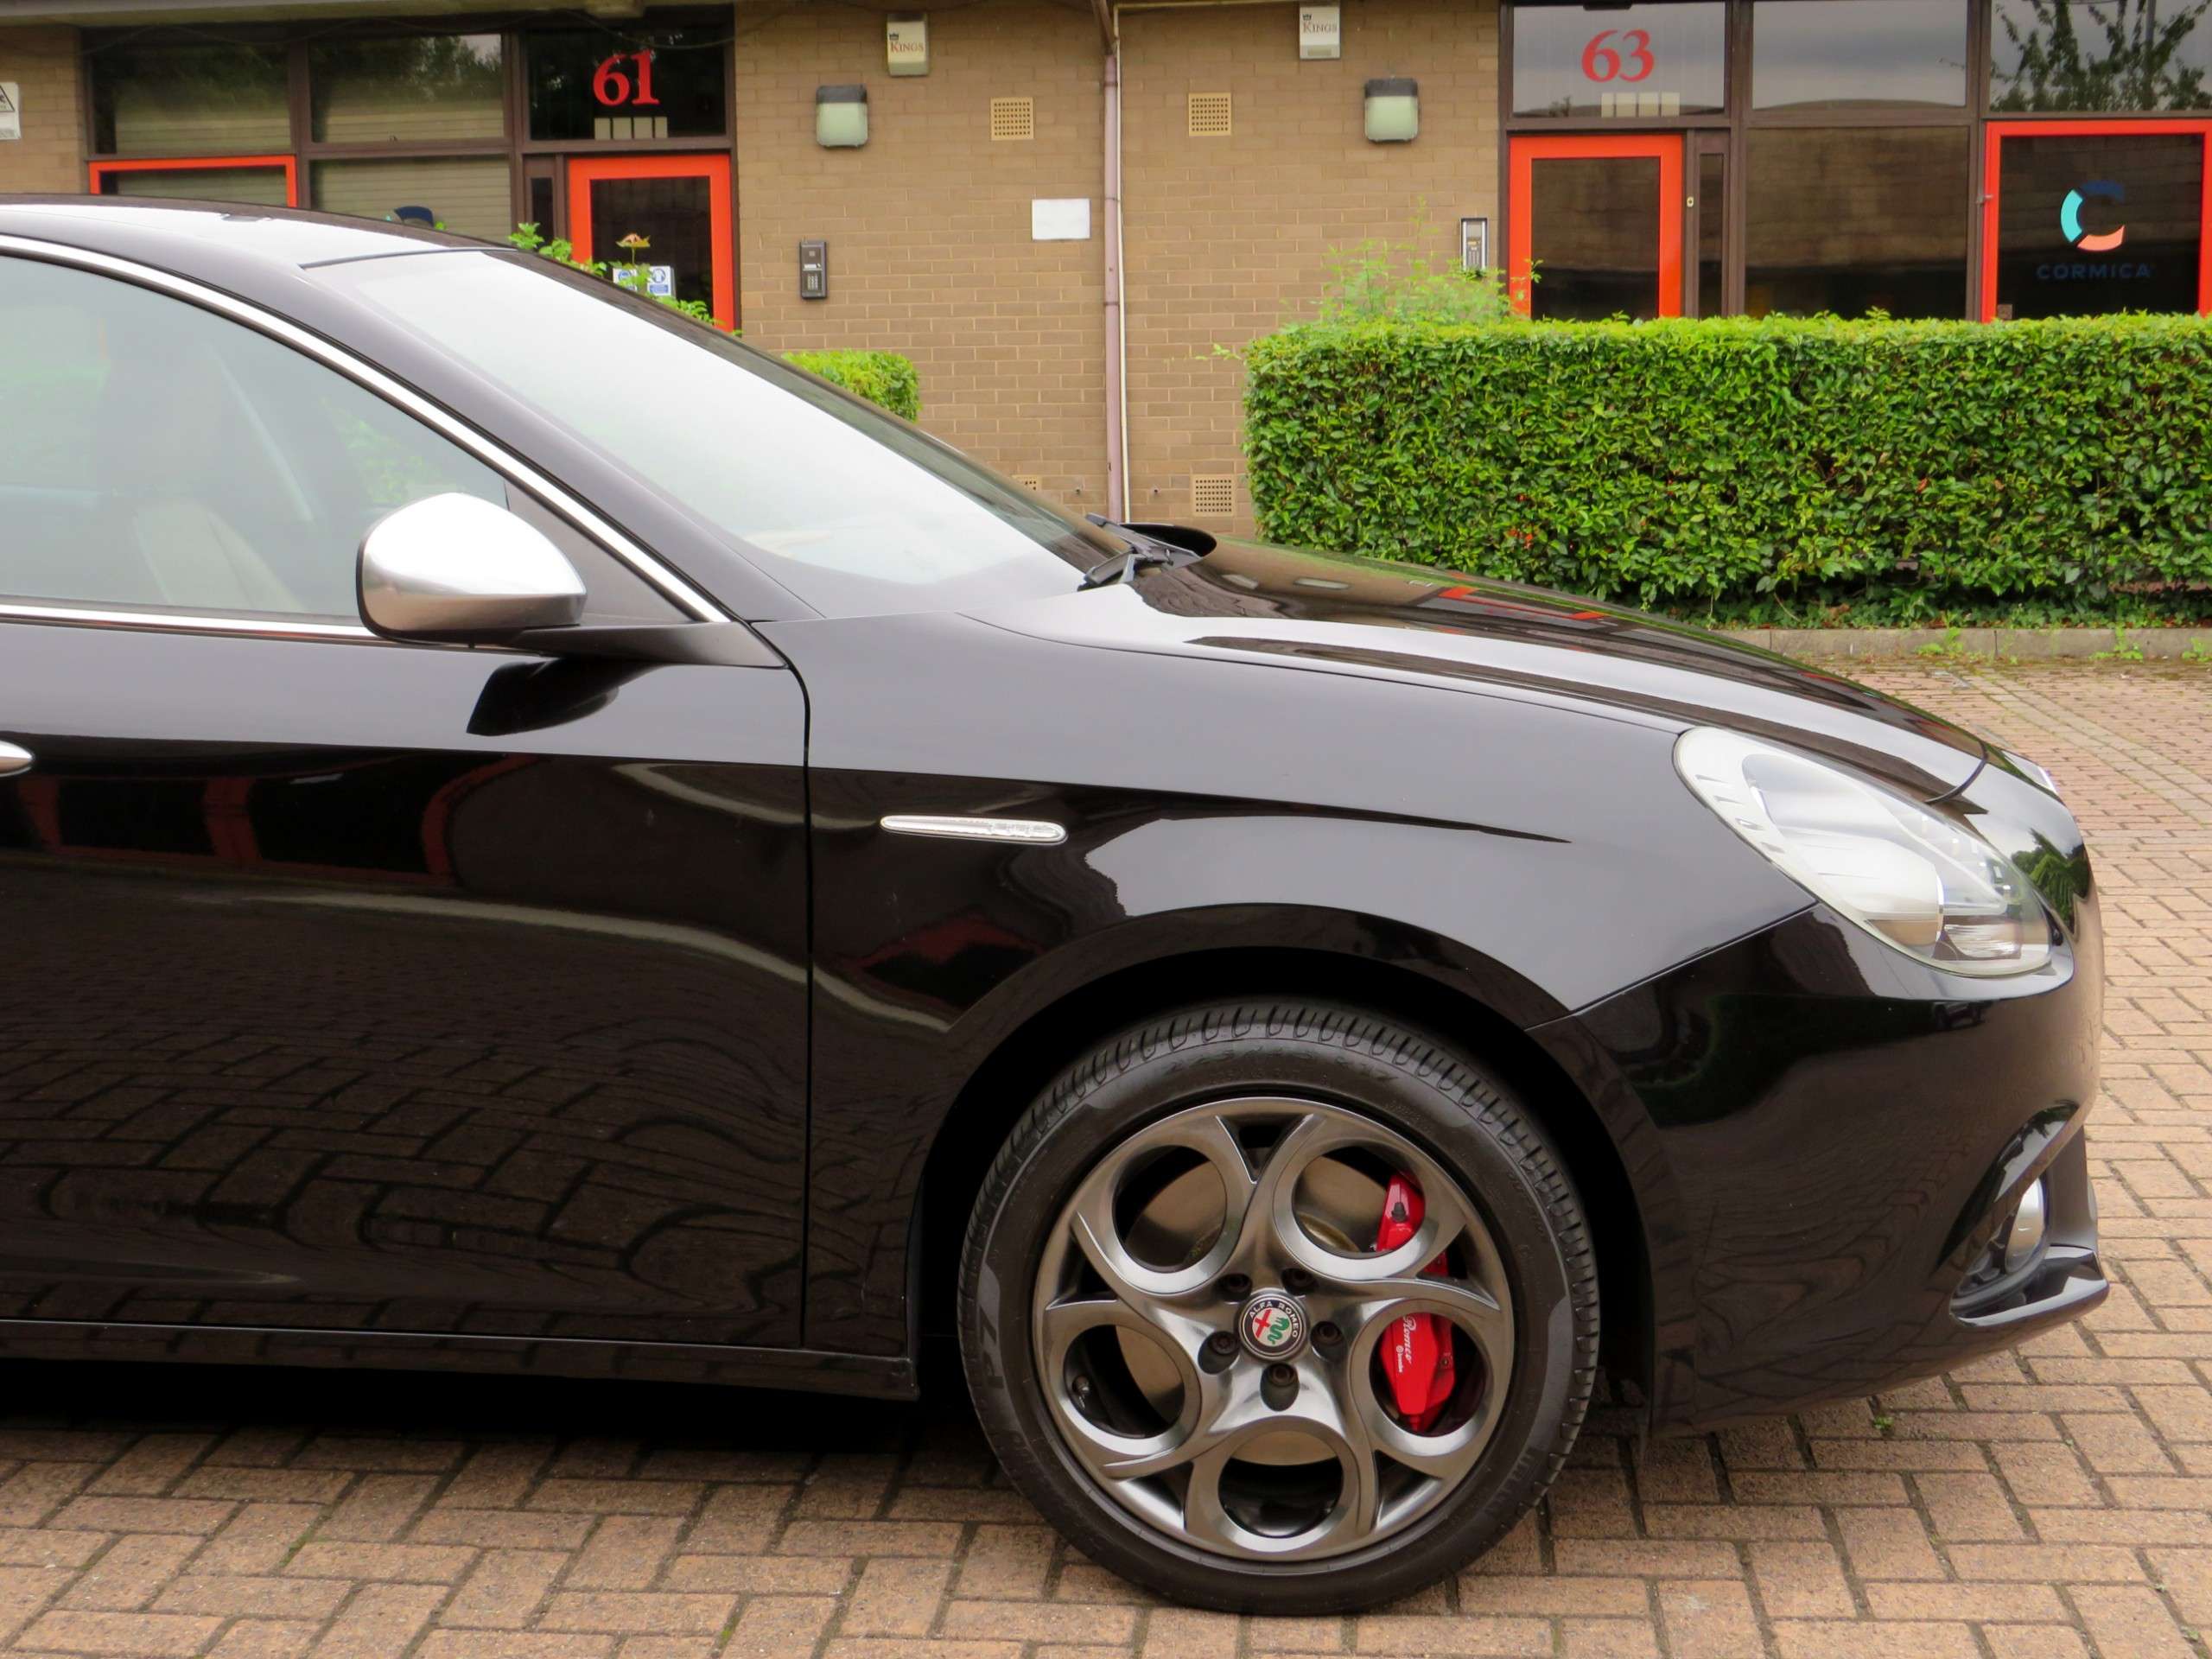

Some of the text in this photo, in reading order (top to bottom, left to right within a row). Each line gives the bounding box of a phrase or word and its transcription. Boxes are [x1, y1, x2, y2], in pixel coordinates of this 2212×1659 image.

[891, 42, 925, 53] KINGS
[1581, 29, 1654, 83] 63
[593, 49, 660, 106] 61
[2037, 262, 2151, 279] CORMICA
[1249, 1301, 1300, 1338] ALFA ROMEO
[1402, 1315, 1417, 1364] Romeo
